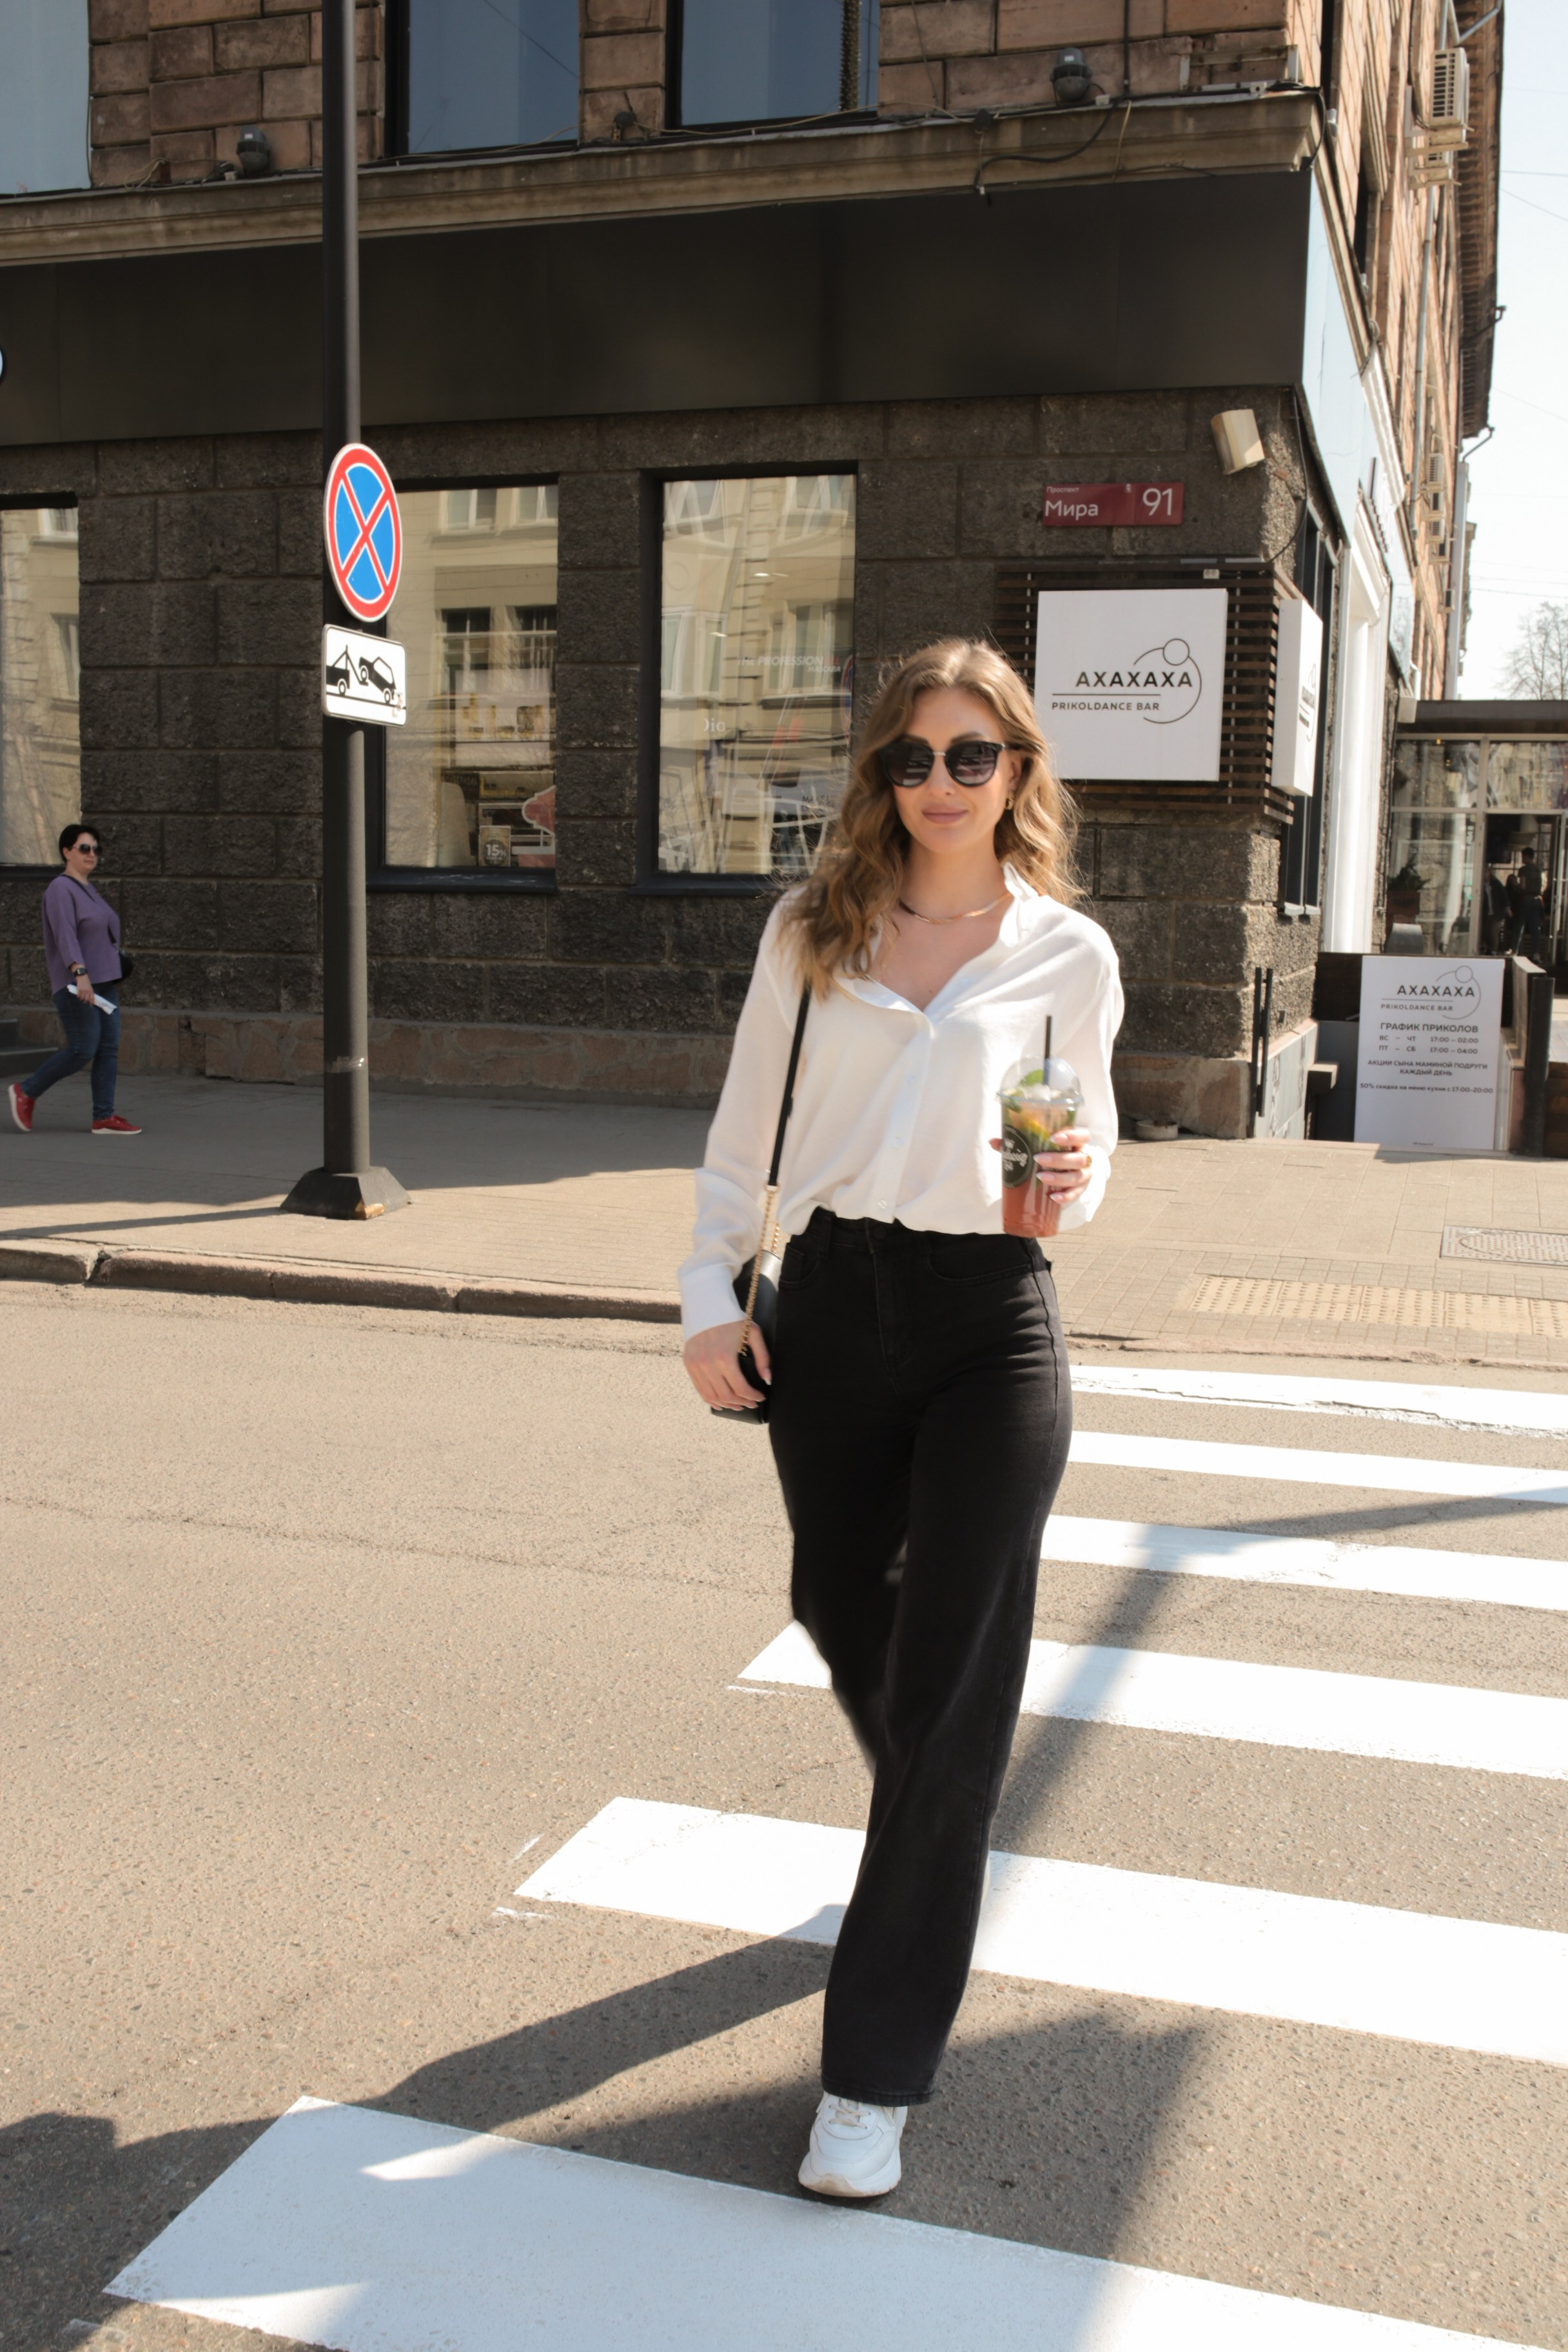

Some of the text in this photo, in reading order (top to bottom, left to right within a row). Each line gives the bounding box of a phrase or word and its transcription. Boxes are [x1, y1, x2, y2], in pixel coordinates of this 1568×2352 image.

[1045, 488, 1172, 520] Мира 91
[485, 844, 507, 857] 15%
[1380, 1023, 1478, 1032] ГРАФИК ПРИКОЛОВ
